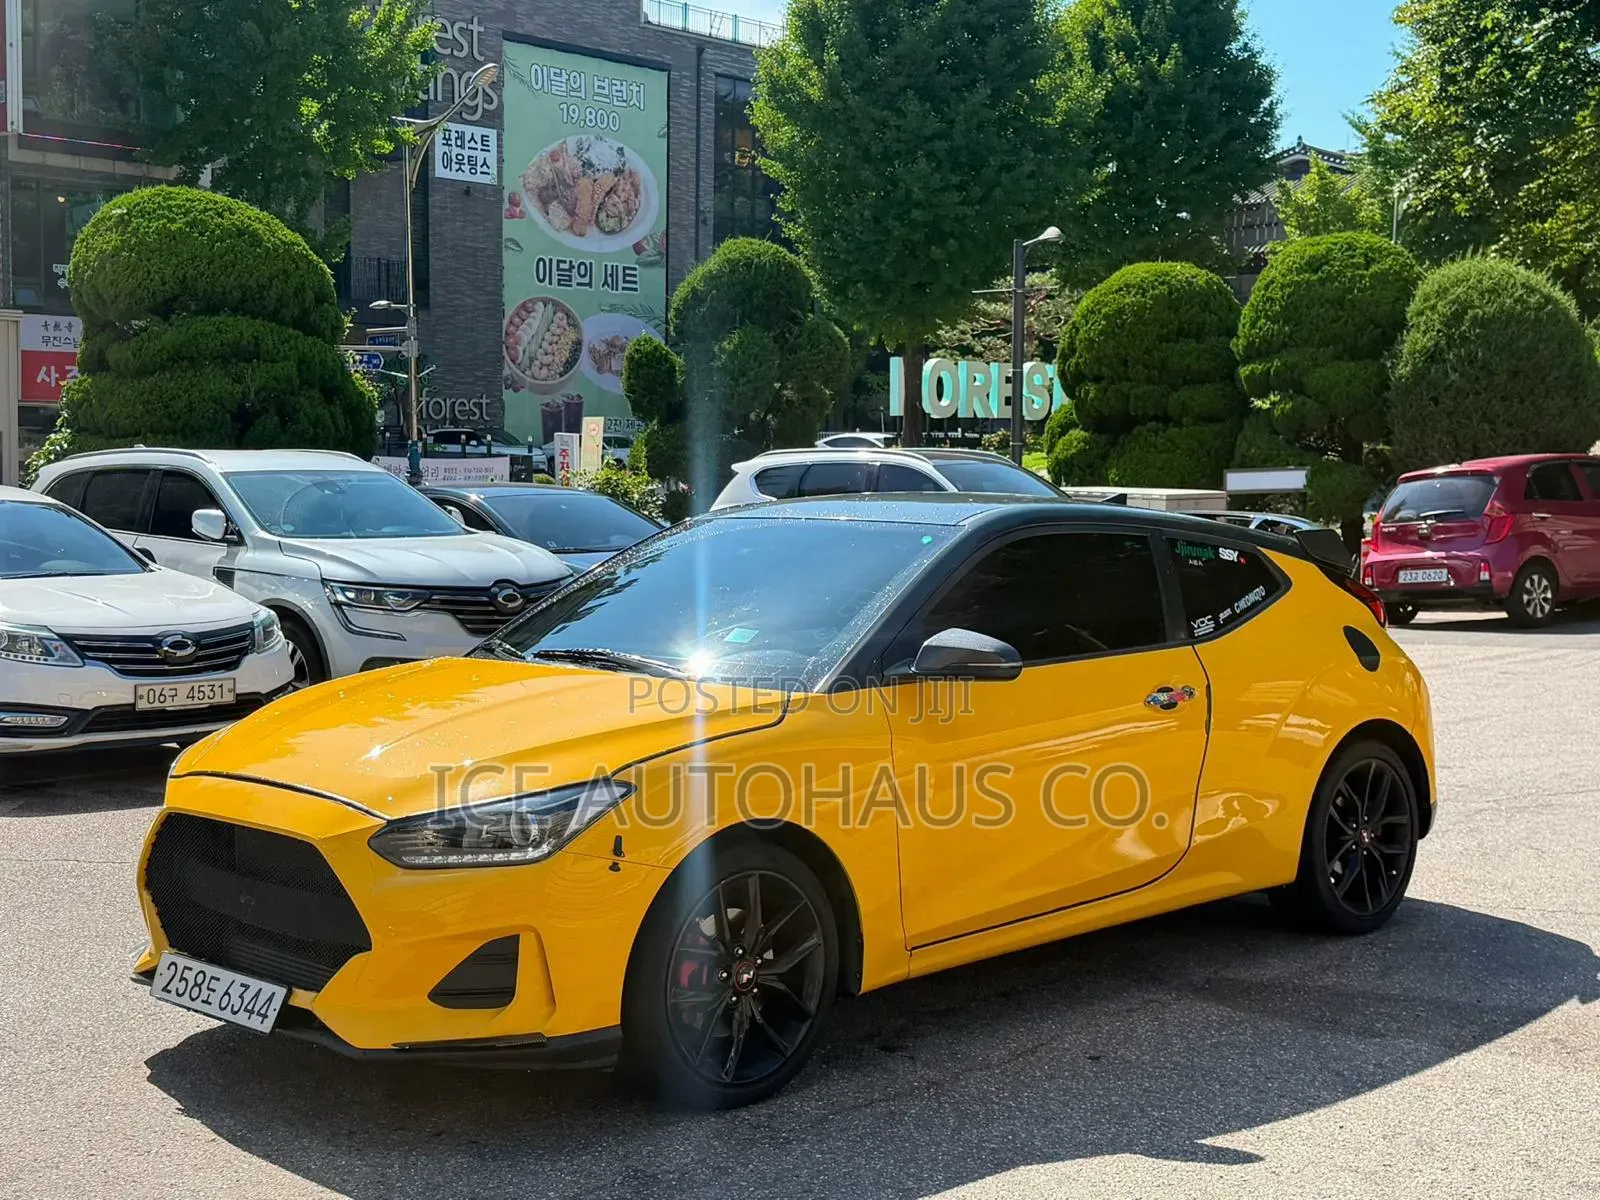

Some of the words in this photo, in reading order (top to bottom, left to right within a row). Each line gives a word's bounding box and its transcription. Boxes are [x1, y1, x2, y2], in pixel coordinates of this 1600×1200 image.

[530, 63, 587, 100] 이달의
[593, 75, 645, 111] 브런치
[559, 102, 620, 132] 19,800
[441, 128, 491, 152] 포레스트
[441, 151, 491, 175] 아웃팅스
[535, 256, 594, 290] 이달의
[601, 263, 639, 293] 세트
[186, 683, 226, 703] 4531
[218, 979, 277, 1025] 6344
